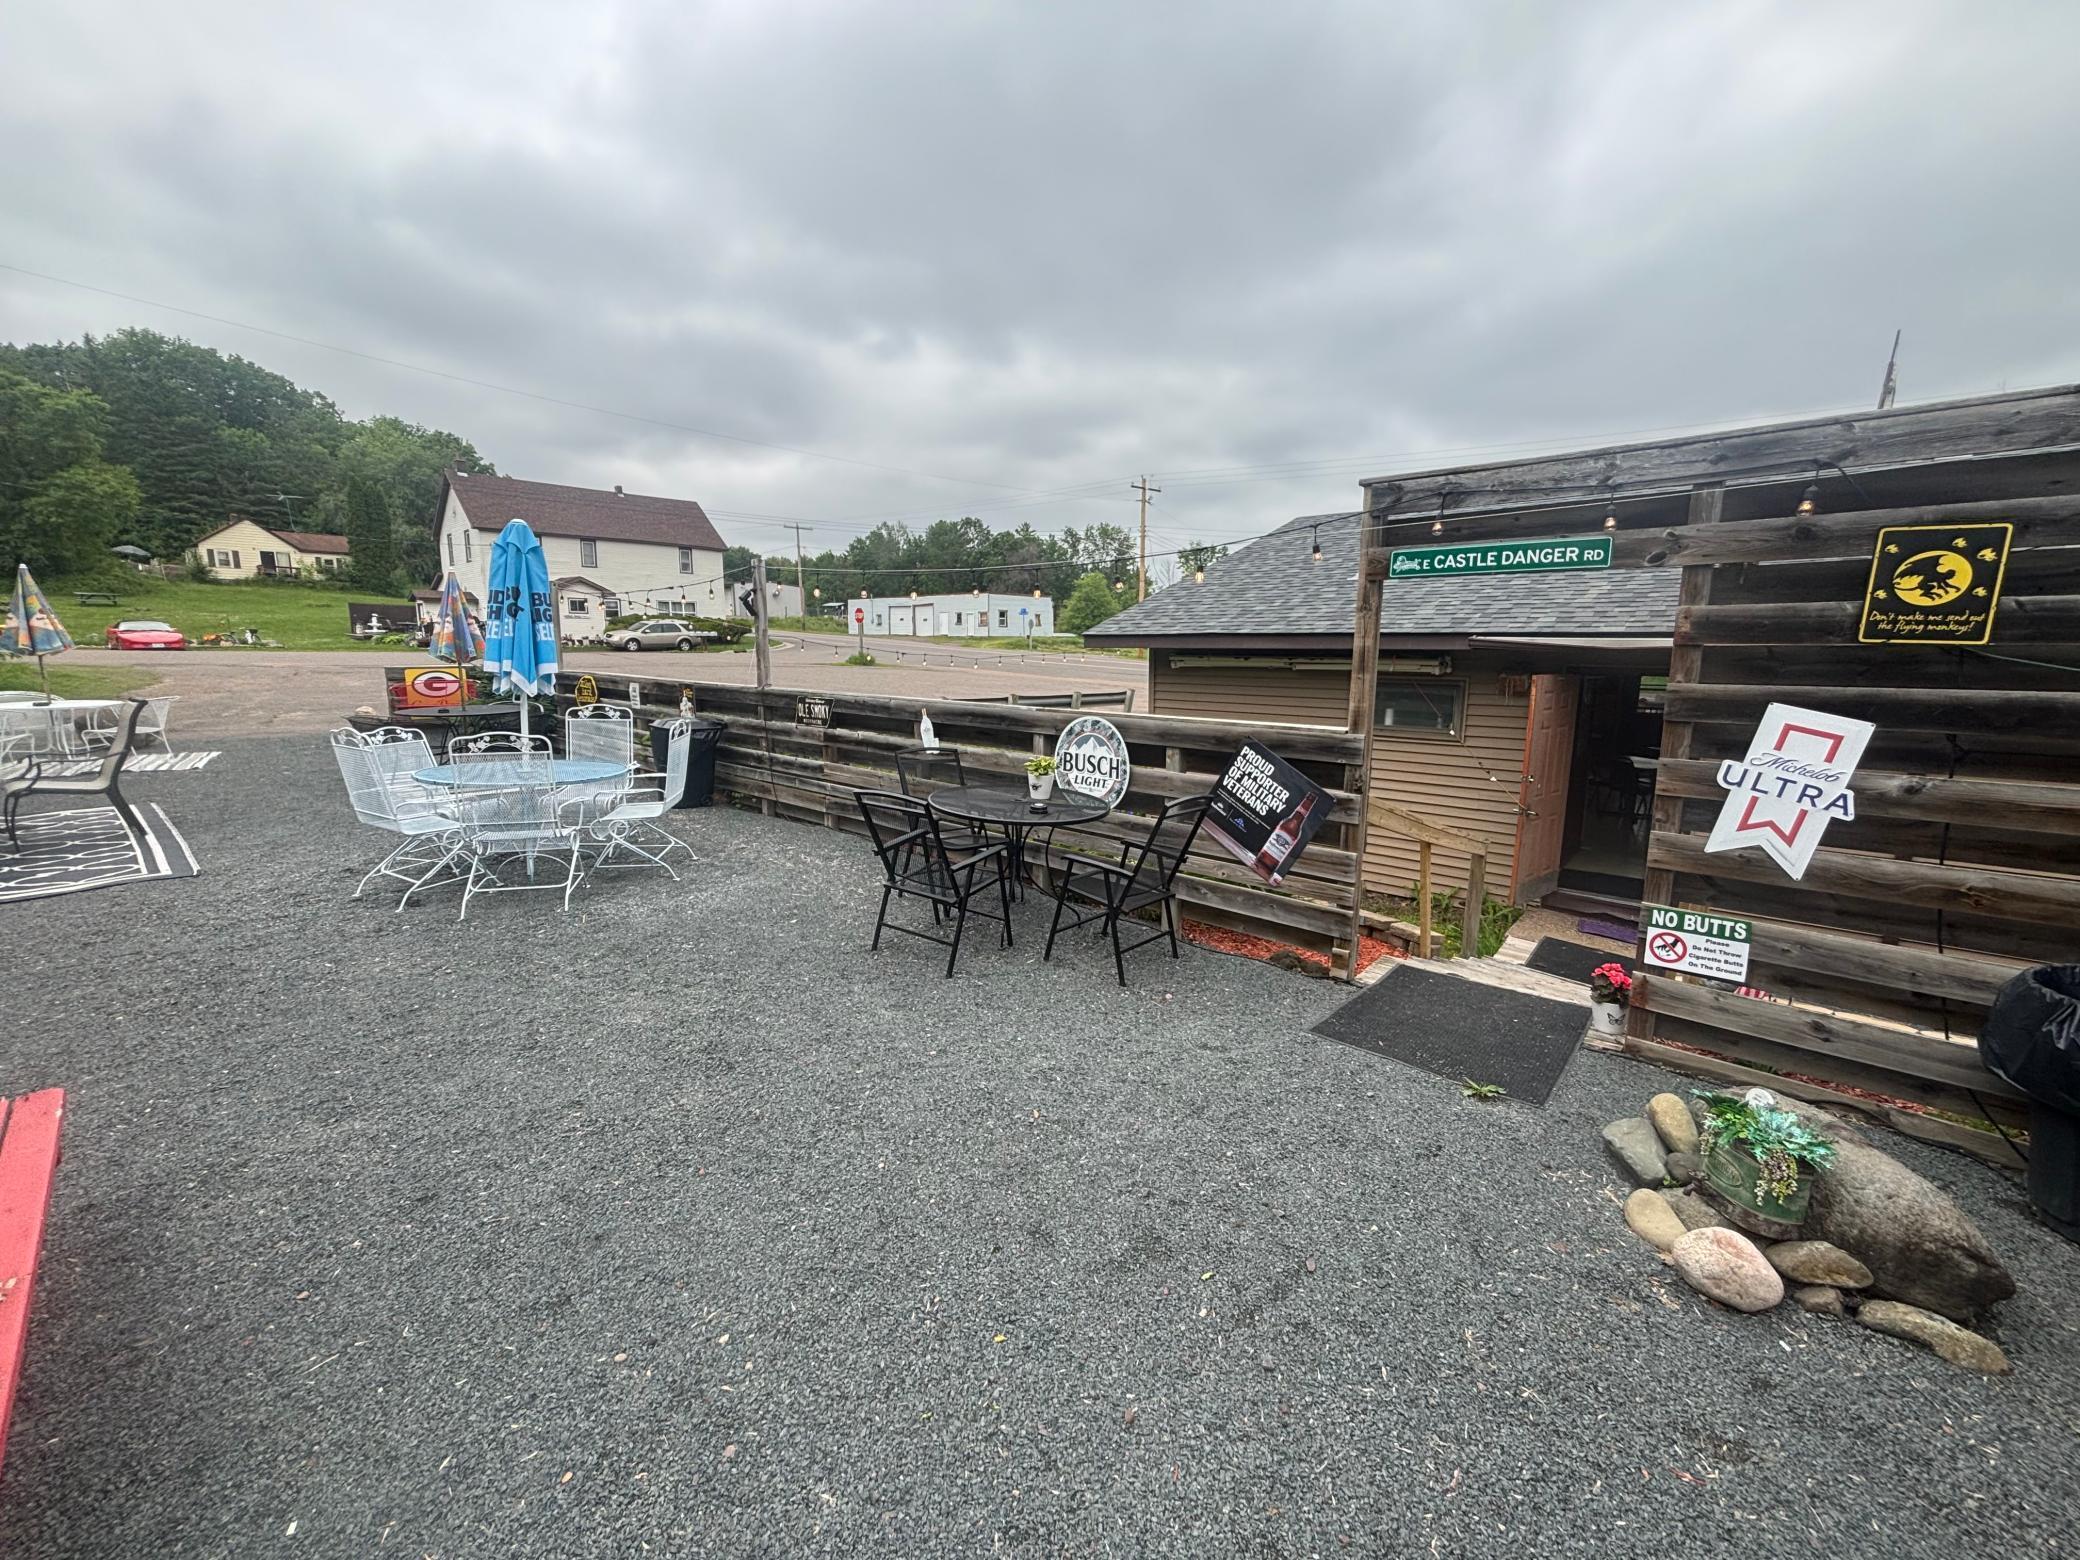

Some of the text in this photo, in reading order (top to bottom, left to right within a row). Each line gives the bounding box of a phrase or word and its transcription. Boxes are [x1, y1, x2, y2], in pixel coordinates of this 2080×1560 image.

[1422, 559, 1430, 569] E
[1434, 551, 1498, 569] CASTLE
[1501, 547, 1579, 565] DANGER
[1583, 549, 1604, 561] RD
[1869, 610, 1895, 621] Don't
[1898, 611, 1924, 621] make
[1945, 610, 1969, 622] send
[1969, 613, 1986, 621] out
[1877, 619, 1976, 635] the flying monkeys!
[1062, 751, 1120, 779] BUSCH
[1240, 745, 1275, 776] PROUD
[1750, 752, 1848, 784] Michelob
[1228, 766, 1242, 782] OF
[1240, 774, 1287, 813] MILITARY
[1234, 756, 1290, 803] SUPPORTER
[1722, 764, 1849, 817] ULTRA
[1222, 774, 1269, 816] VETERANS
[1651, 909, 1747, 940] NO BUTTS
[1692, 944, 1702, 952] Do
[1719, 949, 1743, 959] Throw
[1705, 938, 1730, 948] Please
[1688, 952, 1744, 968] Cigarette Butts
[1700, 963, 1714, 972] The
[1715, 966, 1743, 977] Ground
